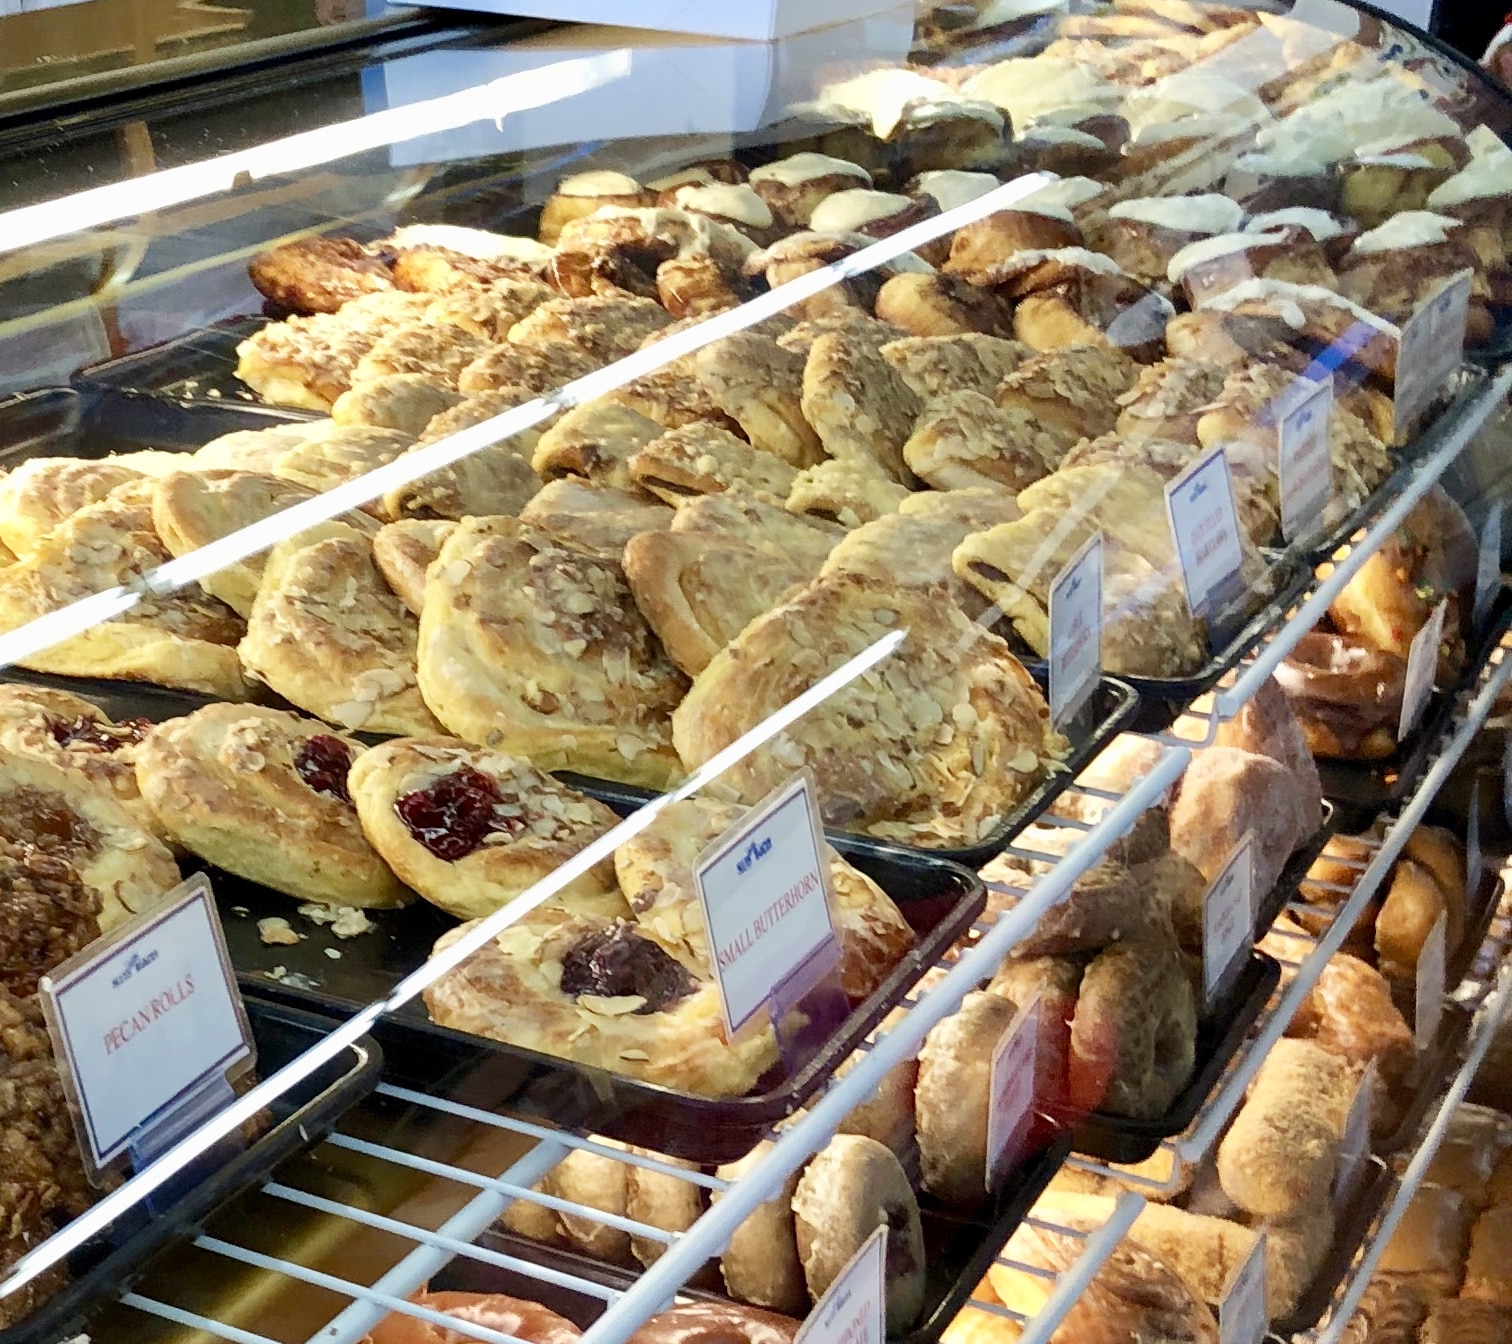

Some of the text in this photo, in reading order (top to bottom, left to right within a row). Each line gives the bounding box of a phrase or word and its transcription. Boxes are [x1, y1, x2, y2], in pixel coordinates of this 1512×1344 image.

[718, 870, 820, 968] SMALL BUTTERHORN
[102, 973, 196, 1056] PECAN ROLLS
